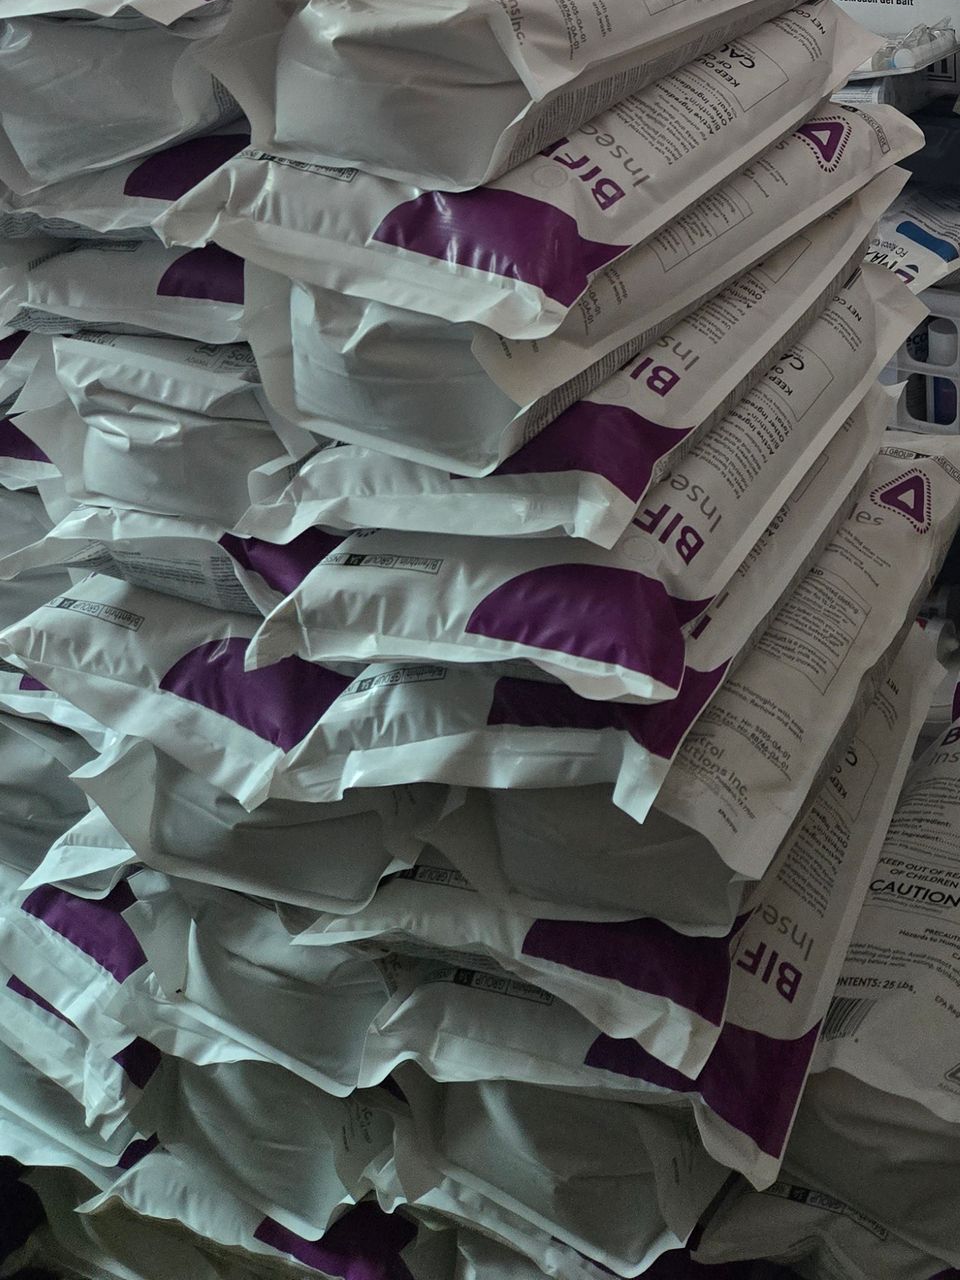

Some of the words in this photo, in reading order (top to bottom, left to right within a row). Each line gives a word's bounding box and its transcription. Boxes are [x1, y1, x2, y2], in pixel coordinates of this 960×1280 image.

[888, 449, 914, 459] GROUP
[879, 857, 904, 868] KEEP
[905, 863, 927, 872] OUT
[929, 868, 944, 877] OF
[906, 872, 959, 889] CHILDREN
[899, 930, 928, 943] Hazards
[882, 979, 894, 989] 25
[934, 995, 948, 1009] EPA
